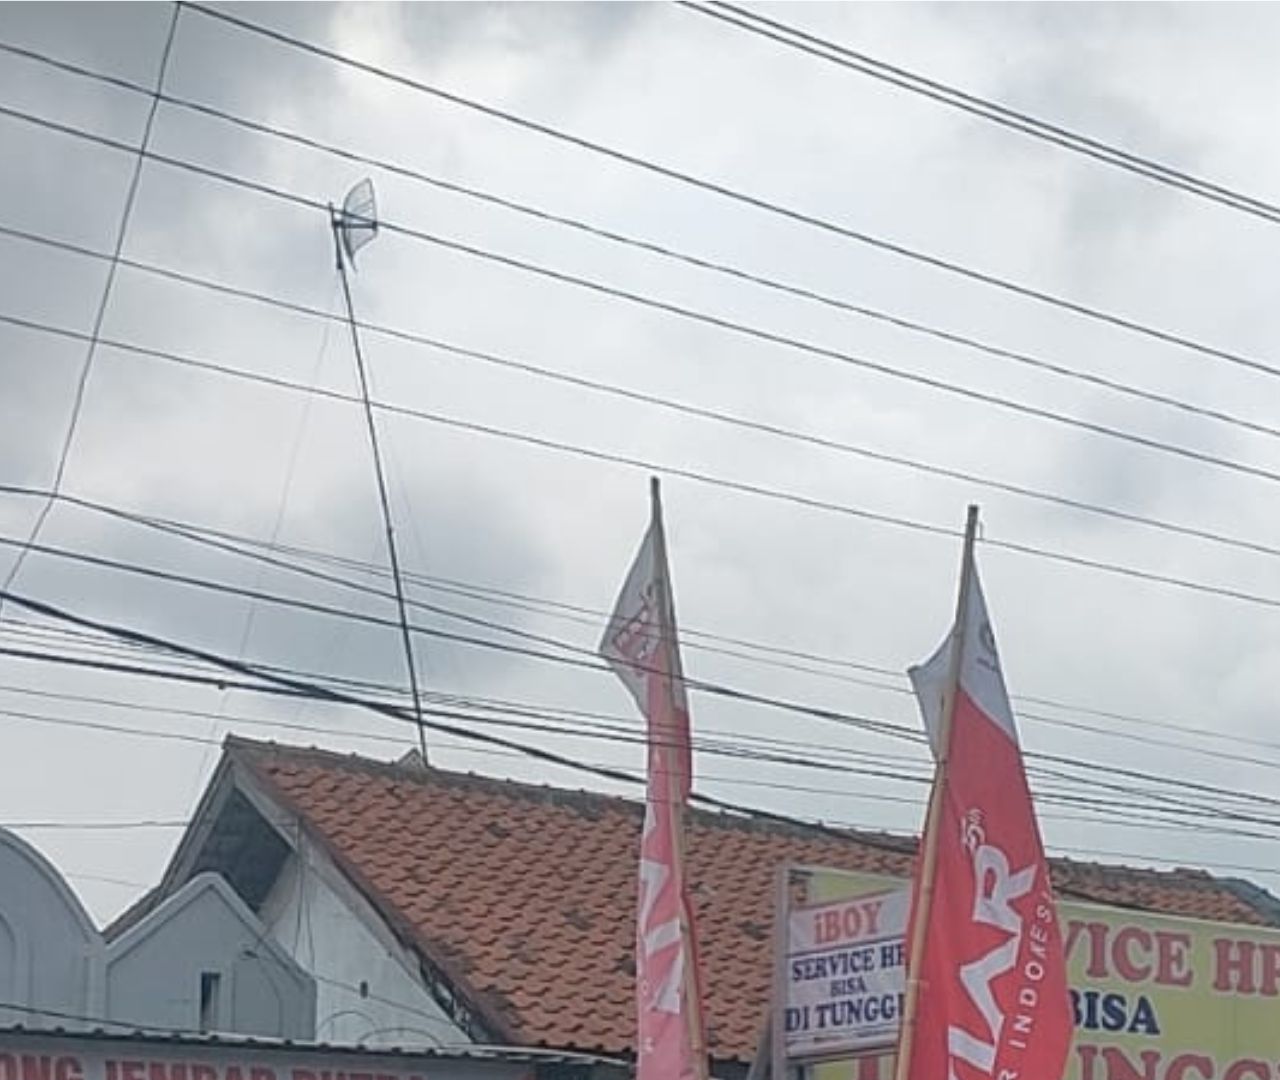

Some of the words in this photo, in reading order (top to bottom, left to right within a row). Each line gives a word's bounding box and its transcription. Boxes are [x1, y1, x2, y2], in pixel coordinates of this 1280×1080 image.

[814, 902, 882, 944] iBOY
[792, 949, 875, 982] SERVICE
[830, 976, 867, 997] BISA
[785, 1006, 810, 1032] DI
